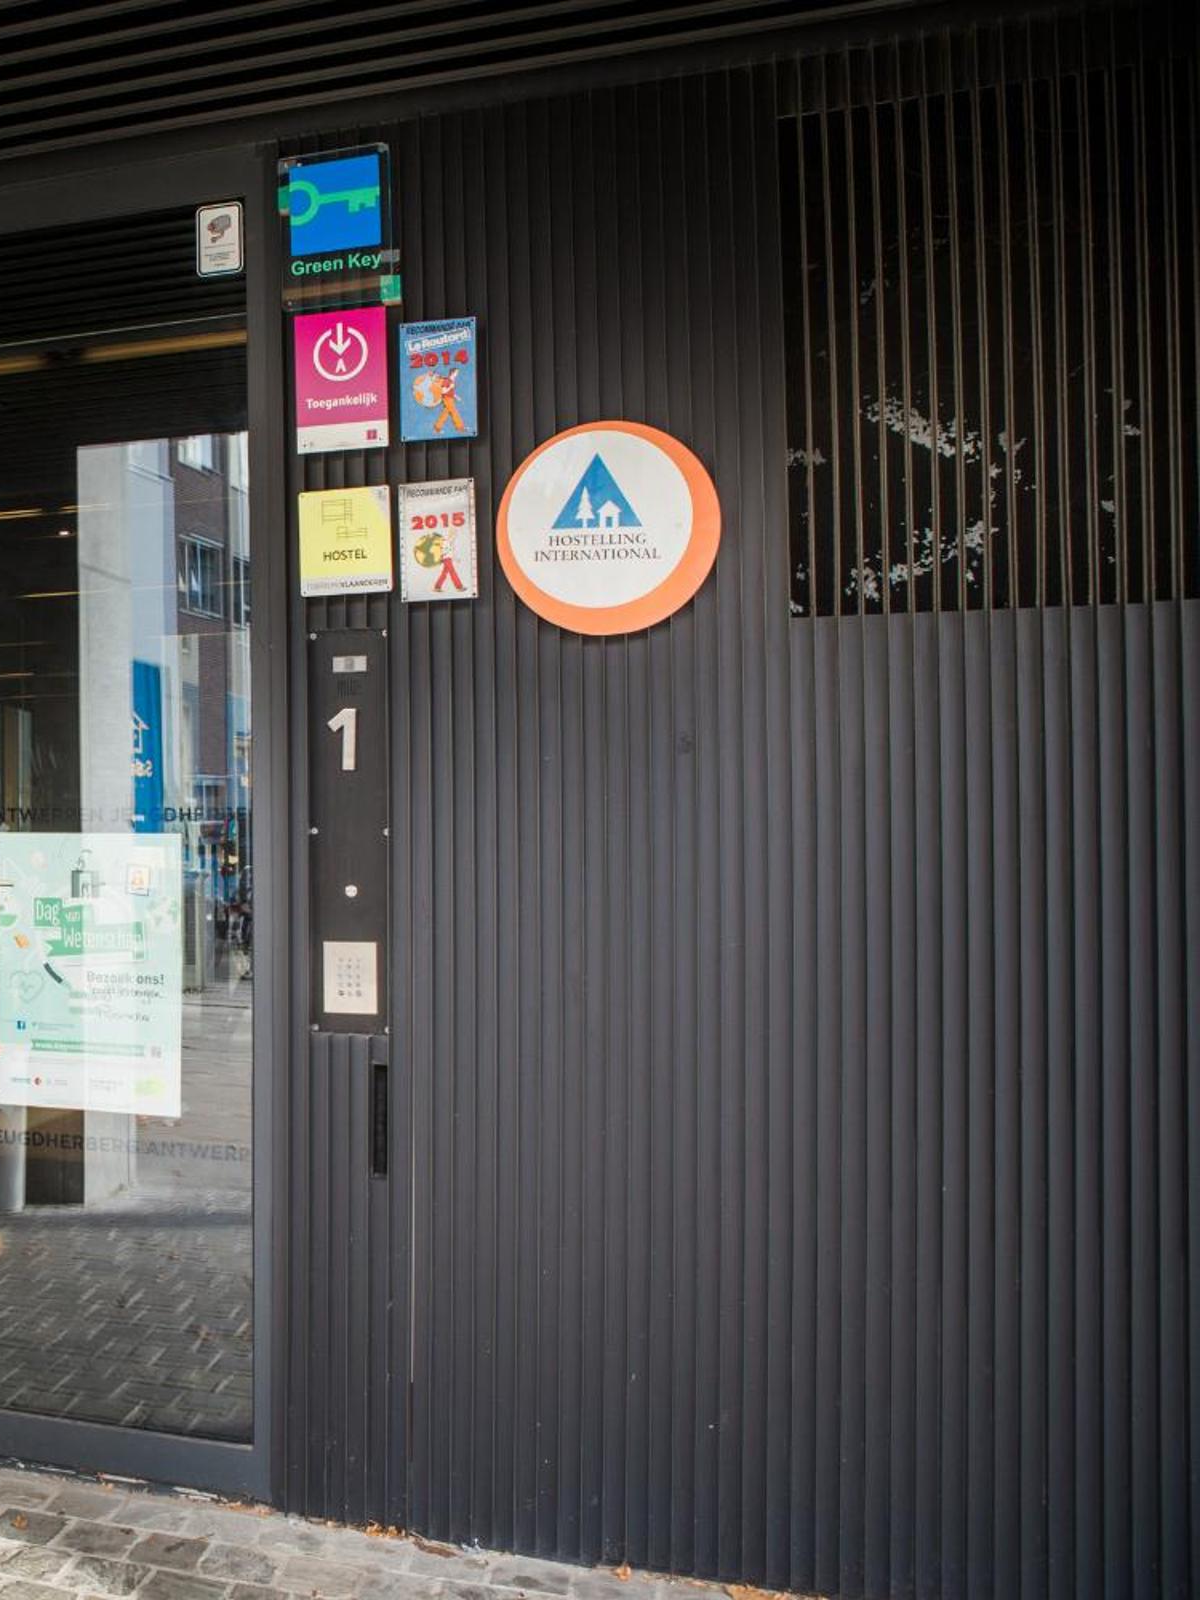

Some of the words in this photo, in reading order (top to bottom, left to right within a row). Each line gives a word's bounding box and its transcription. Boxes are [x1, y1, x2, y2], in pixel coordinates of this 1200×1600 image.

[290, 258, 343, 276] Green
[348, 253, 382, 269] Key
[409, 348, 468, 369] 2014
[305, 393, 378, 410] Toegankelijk
[411, 511, 465, 530] 2015
[548, 533, 647, 547] HOSTELLING
[323, 548, 368, 562] HOSTEL
[534, 548, 662, 562] INTERNATIONAL
[326, 708, 359, 771] 1
[35, 899, 60, 925] Dag
[136, 973, 165, 985] ons!
